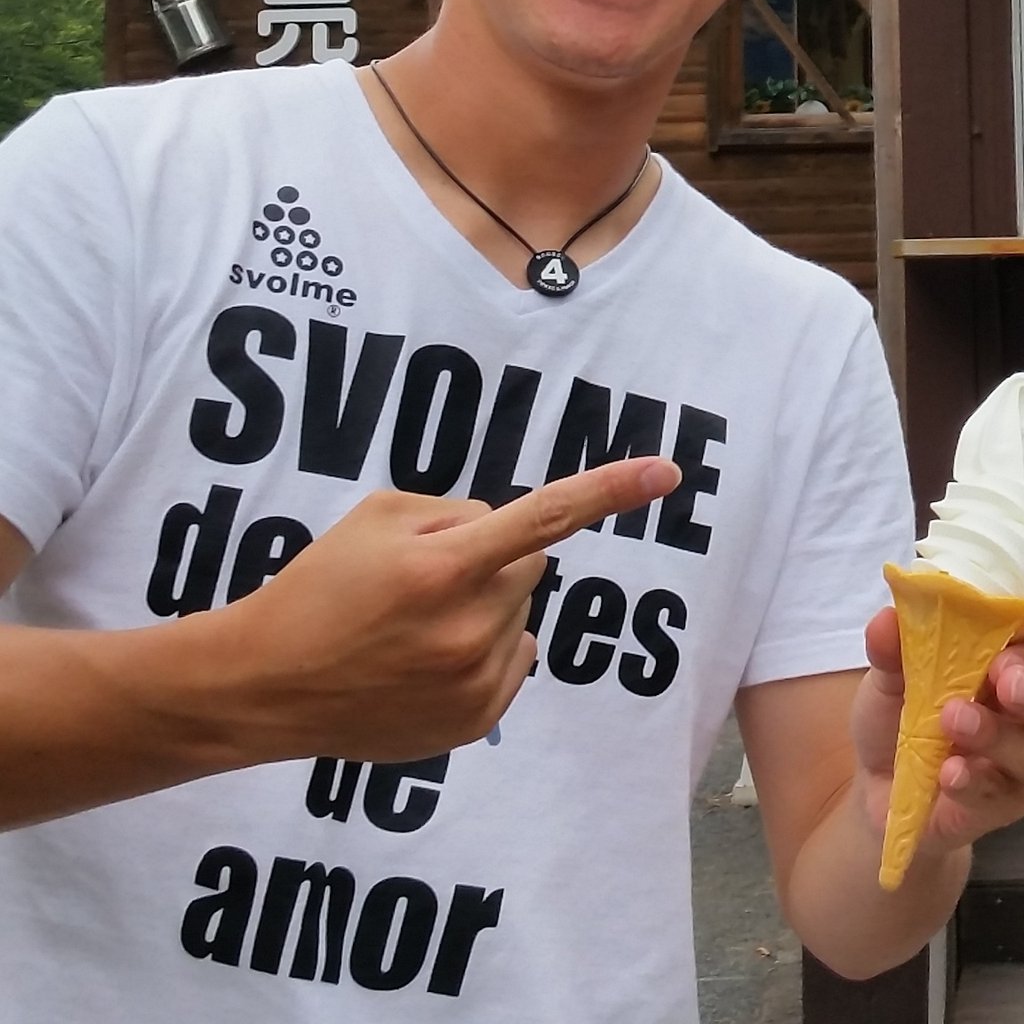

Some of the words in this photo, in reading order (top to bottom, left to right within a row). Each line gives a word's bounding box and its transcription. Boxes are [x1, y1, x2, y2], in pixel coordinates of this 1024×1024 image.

[229, 263, 358, 307] svolme
[541, 258, 568, 285] 4
[188, 304, 728, 556] SVOLME
[180, 845, 504, 998] amor
